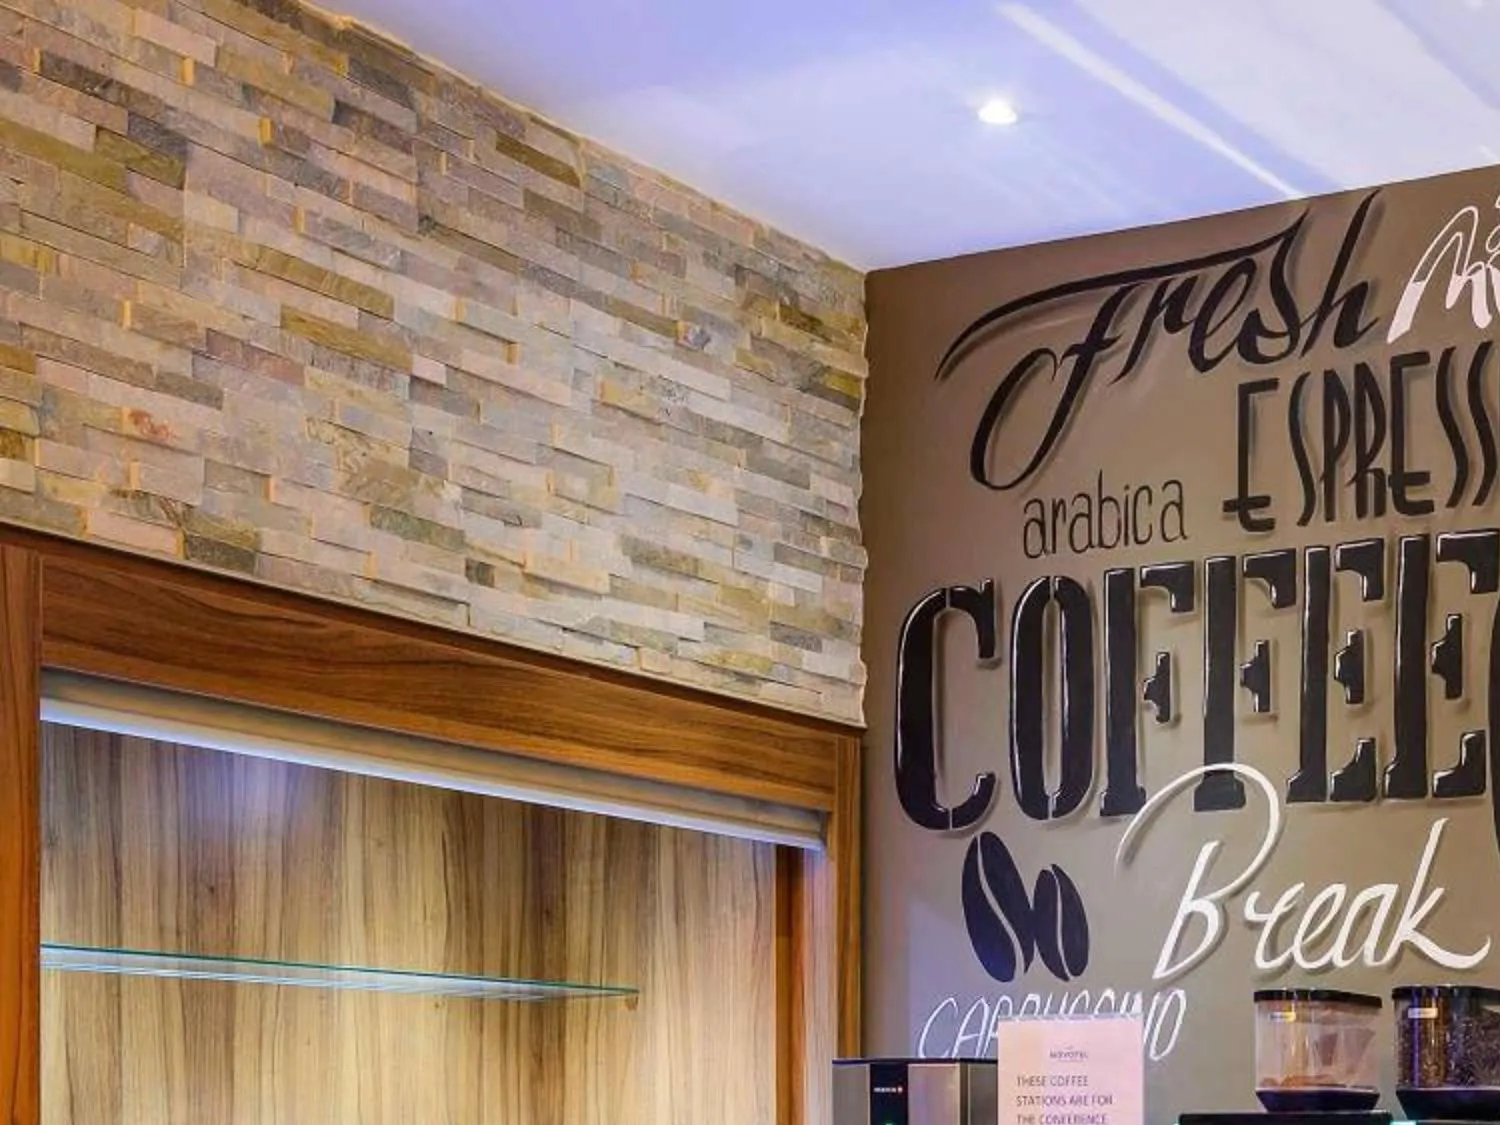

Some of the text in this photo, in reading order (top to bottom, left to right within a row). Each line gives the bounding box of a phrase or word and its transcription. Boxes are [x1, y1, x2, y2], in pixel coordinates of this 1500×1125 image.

[1022, 467, 1188, 560] arabica
[894, 528, 1500, 832] COFFEE
[1115, 762, 1490, 981] Break
[1016, 1093, 1113, 1107] STATIONS ARE FOR
[1017, 1074, 1088, 1088] THESE COFFEE
[1017, 1113, 1108, 1125] THE CONFERENCE
